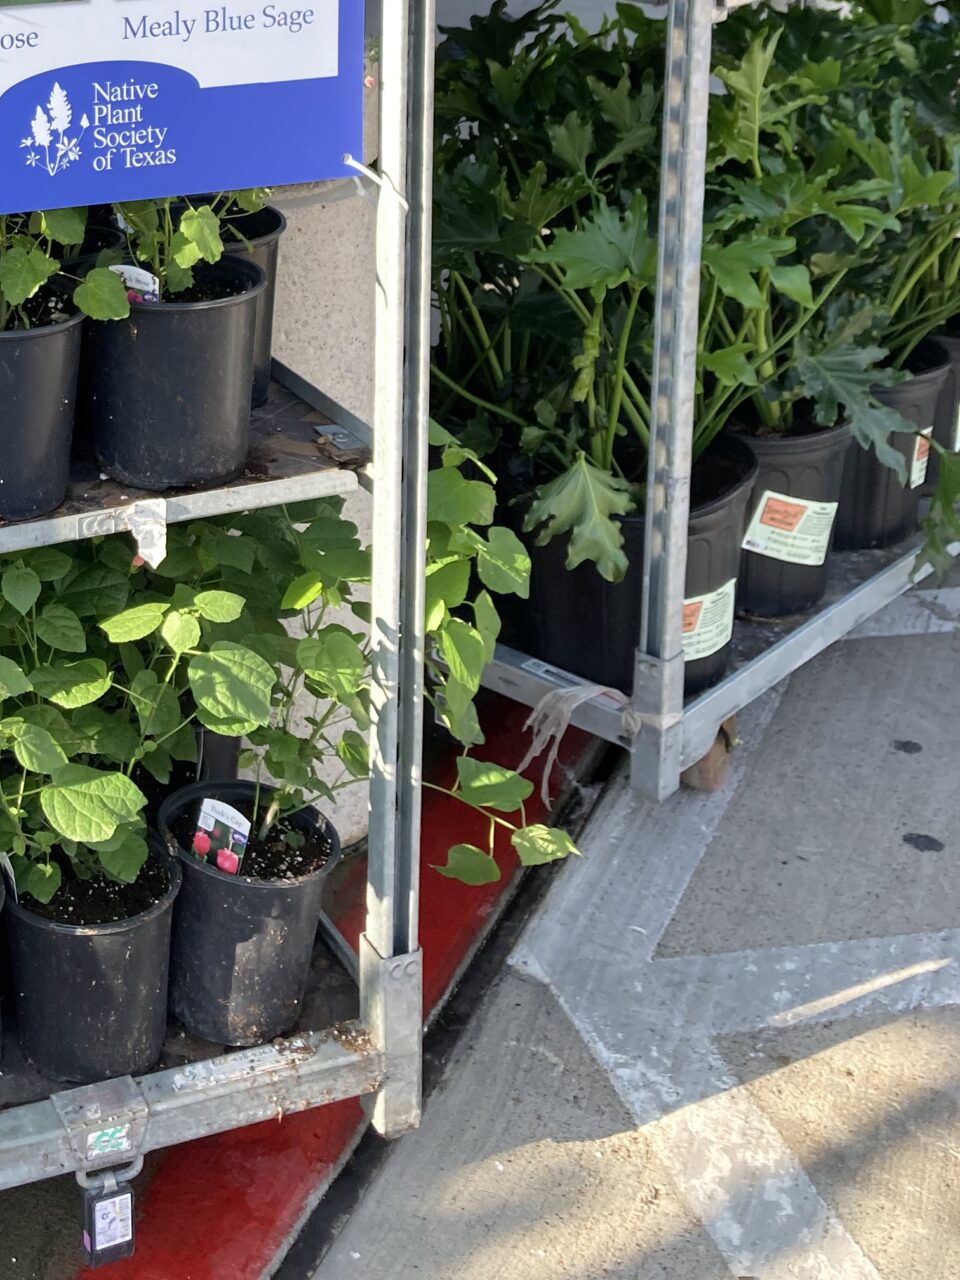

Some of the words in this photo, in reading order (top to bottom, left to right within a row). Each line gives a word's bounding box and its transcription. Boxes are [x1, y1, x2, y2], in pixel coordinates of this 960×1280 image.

[122, 10, 196, 42] Mealy
[204, 7, 255, 33] Blue
[263, 5, 314, 33] Sage
[92, 79, 158, 104] Native
[92, 104, 143, 126] Plant
[93, 124, 168, 148] Society
[93, 149, 116, 171] of
[120, 147, 177, 169] Texas
